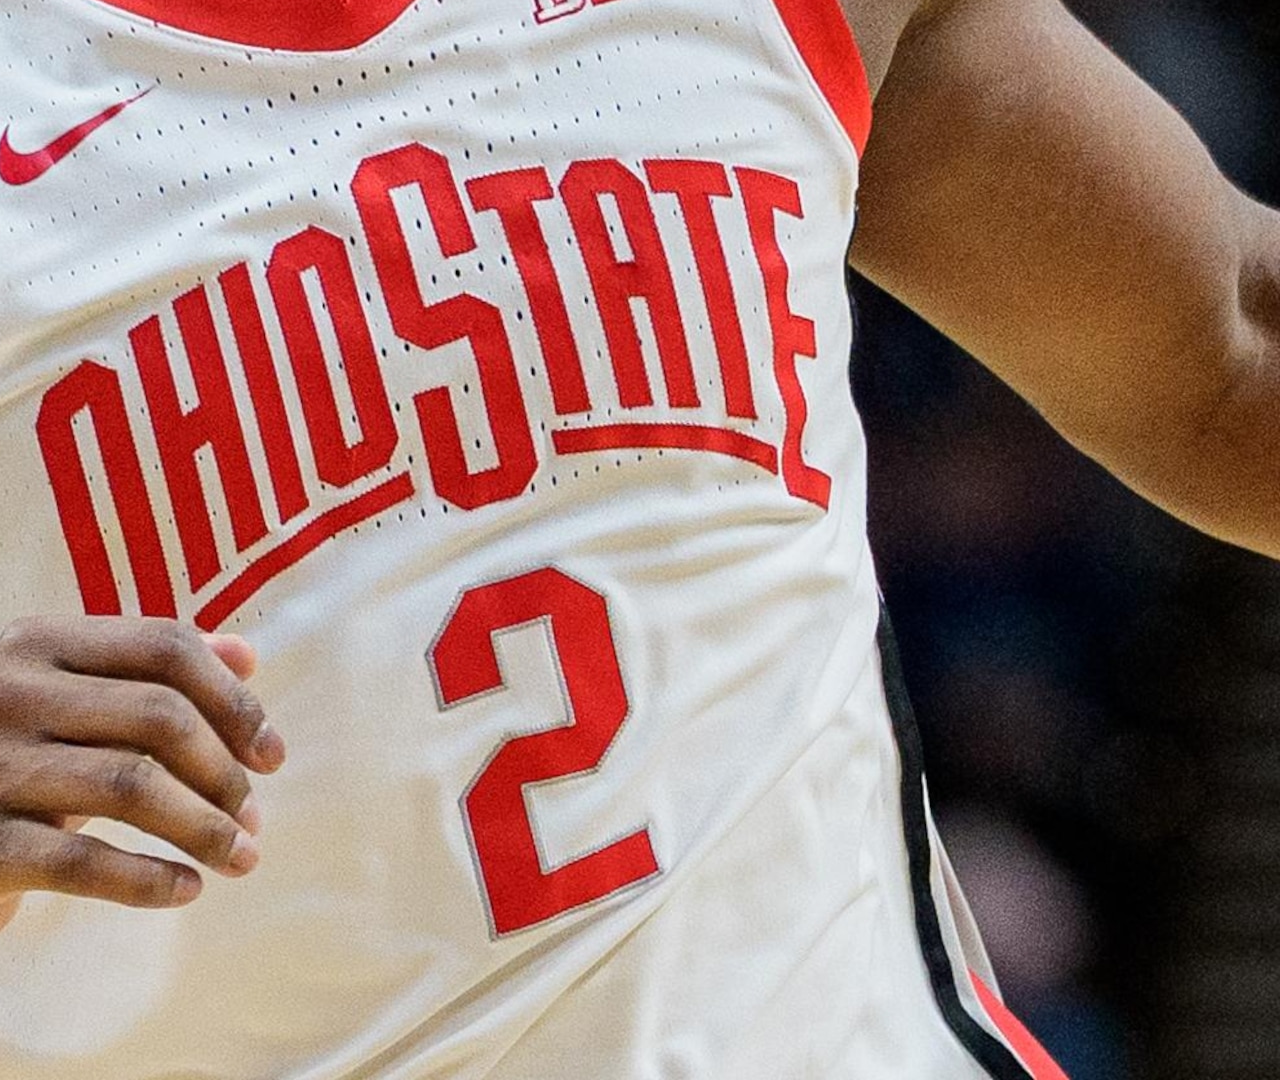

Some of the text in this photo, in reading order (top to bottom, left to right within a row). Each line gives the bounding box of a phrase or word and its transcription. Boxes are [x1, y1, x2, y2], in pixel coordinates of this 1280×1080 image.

[35, 141, 833, 618] OHIO STATE
[424, 565, 664, 940] 2
